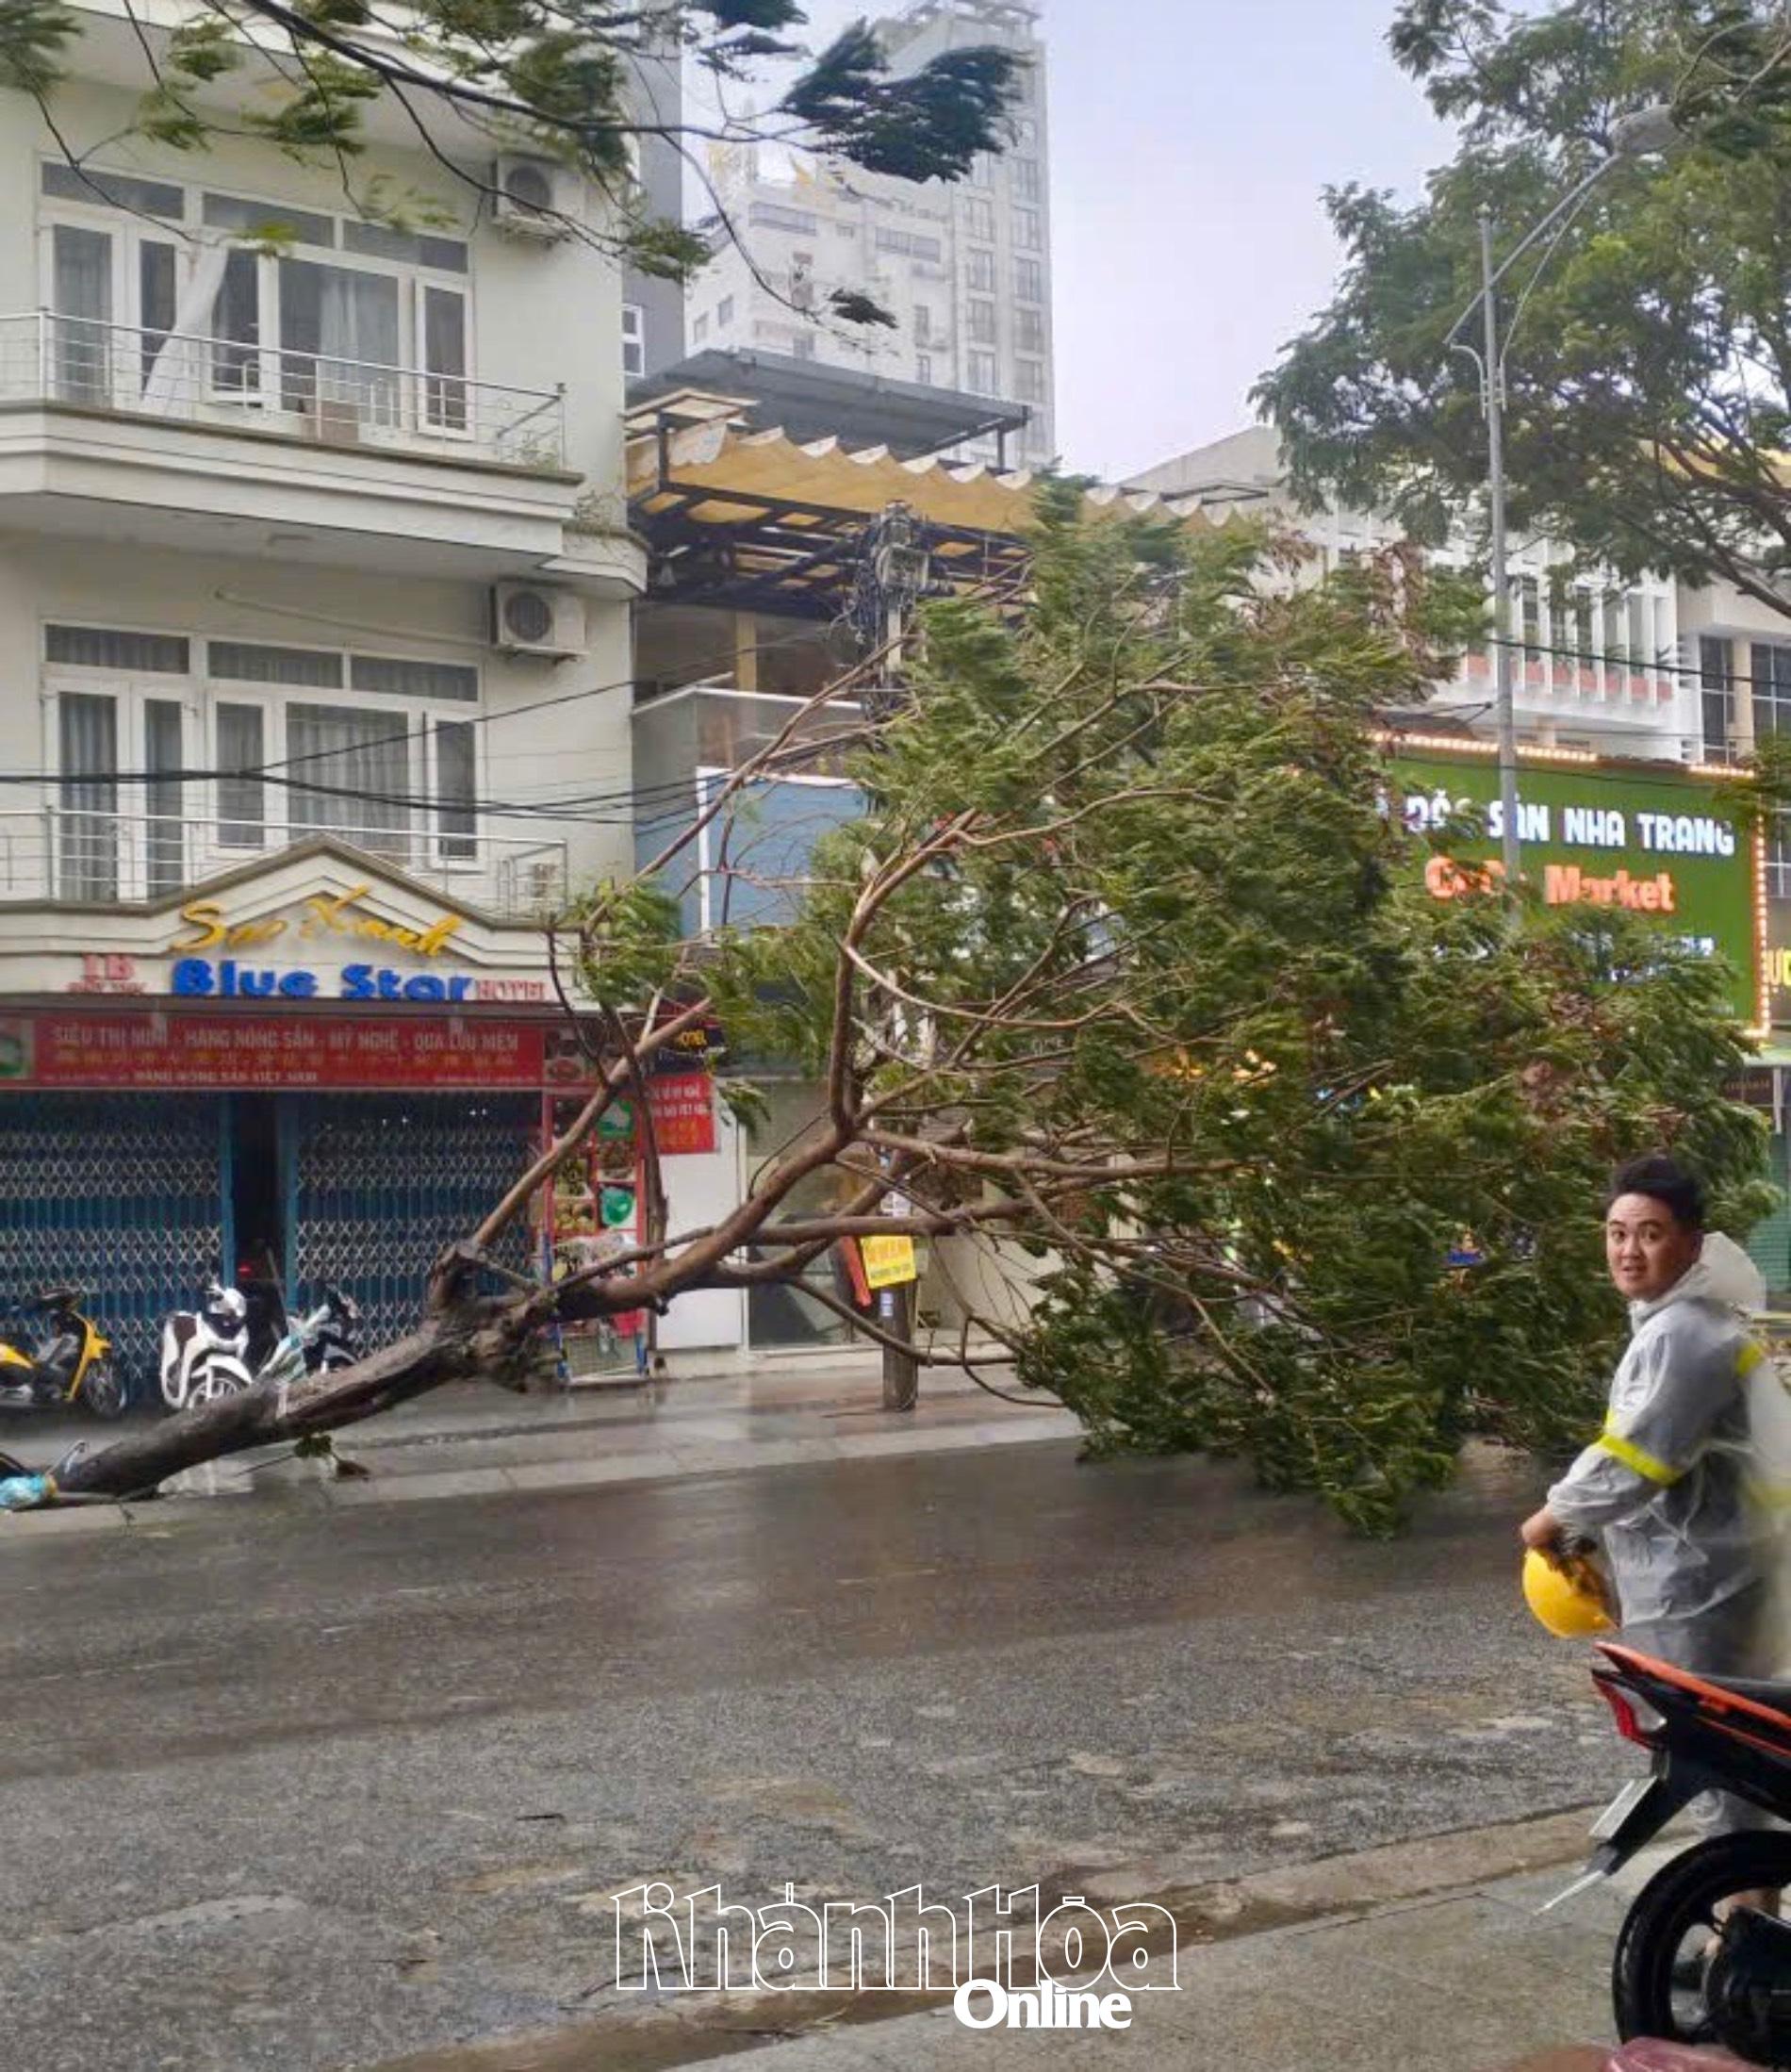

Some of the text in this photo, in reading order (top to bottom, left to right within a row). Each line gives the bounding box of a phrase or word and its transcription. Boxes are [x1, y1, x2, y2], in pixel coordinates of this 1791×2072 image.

[1564, 807, 1626, 847] NHA
[1636, 813, 1735, 857] TRANG
[1543, 863, 1675, 912] Market
[171, 956, 319, 997] Blue
[340, 962, 475, 1001] Star
